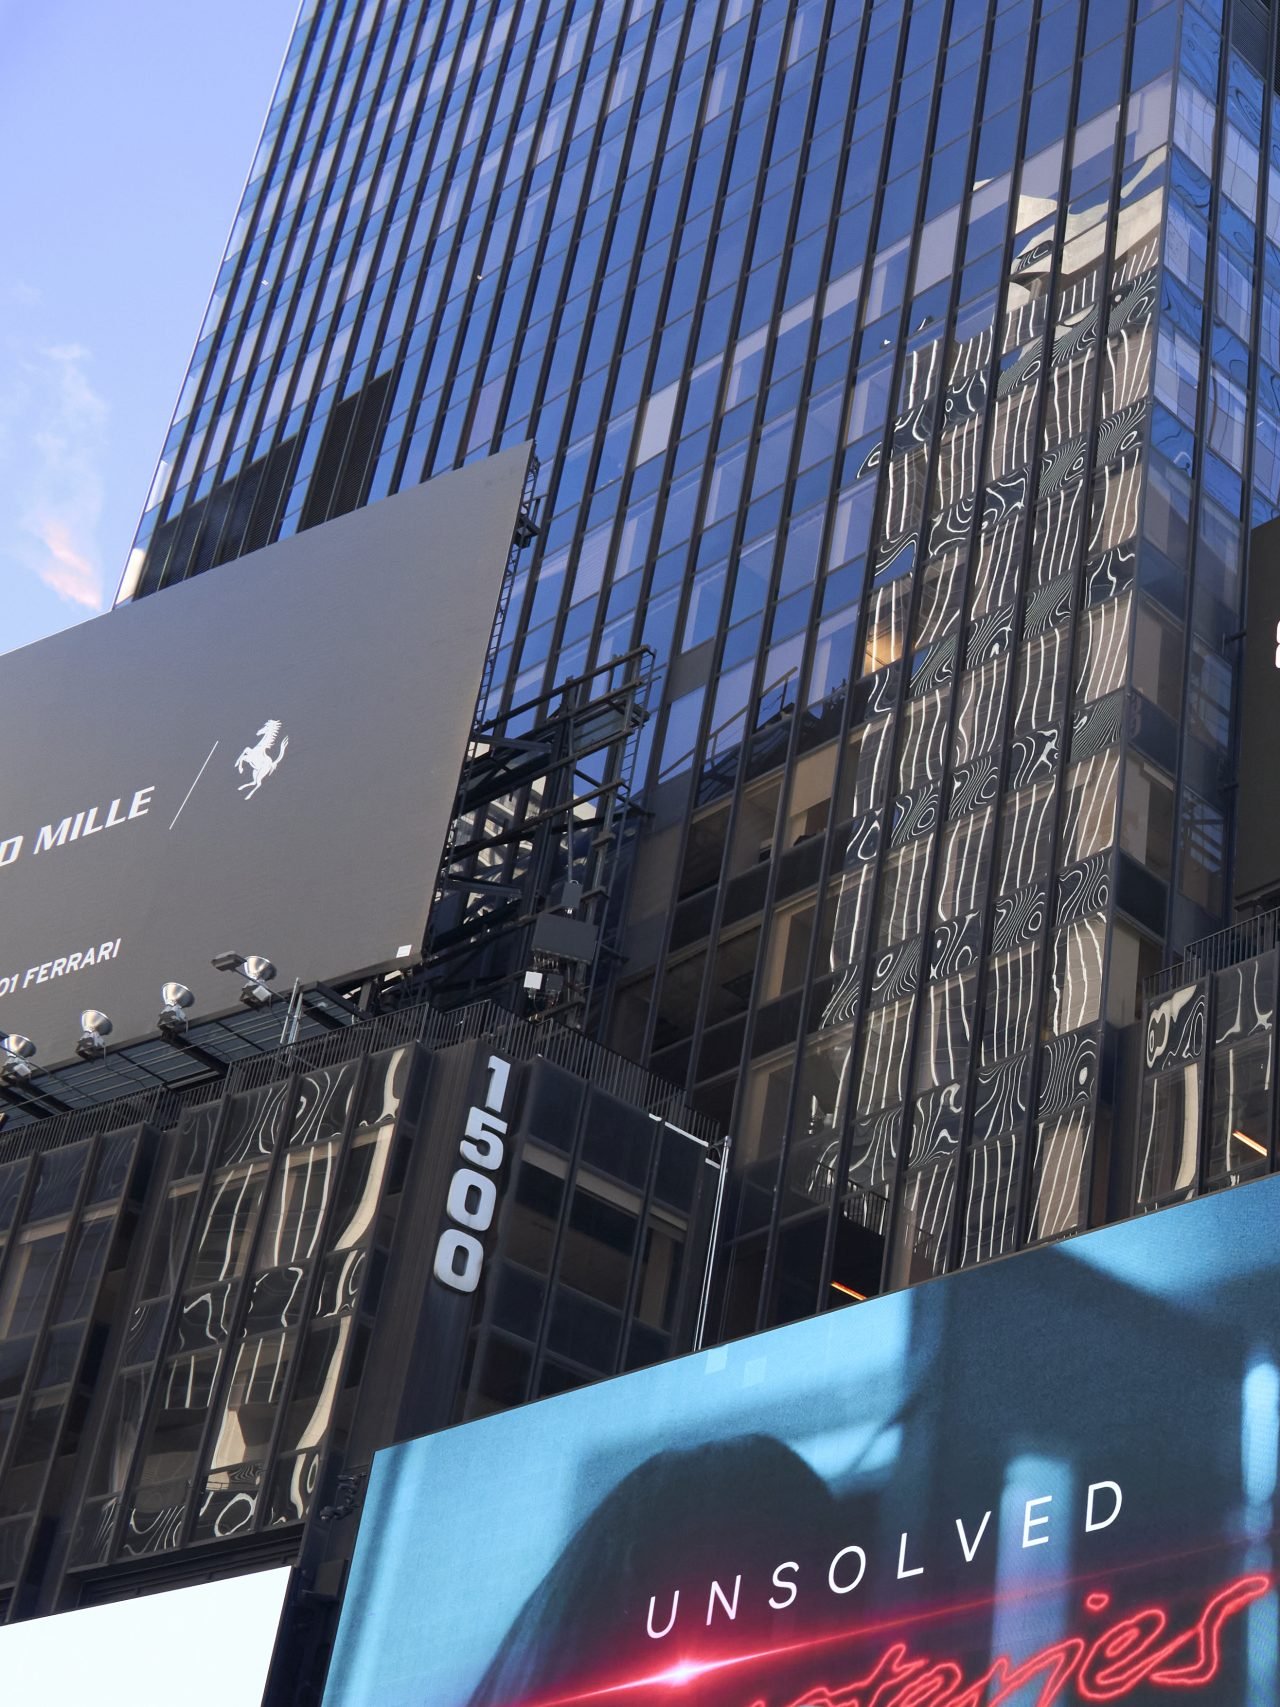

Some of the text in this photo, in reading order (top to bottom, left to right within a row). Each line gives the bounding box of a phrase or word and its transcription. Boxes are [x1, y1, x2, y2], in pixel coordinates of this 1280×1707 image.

[33, 785, 156, 855] MILLE
[22, 937, 122, 989] FERRARI
[433, 1055, 511, 1293] 1500
[646, 1480, 1123, 1639] UNSOLVED
